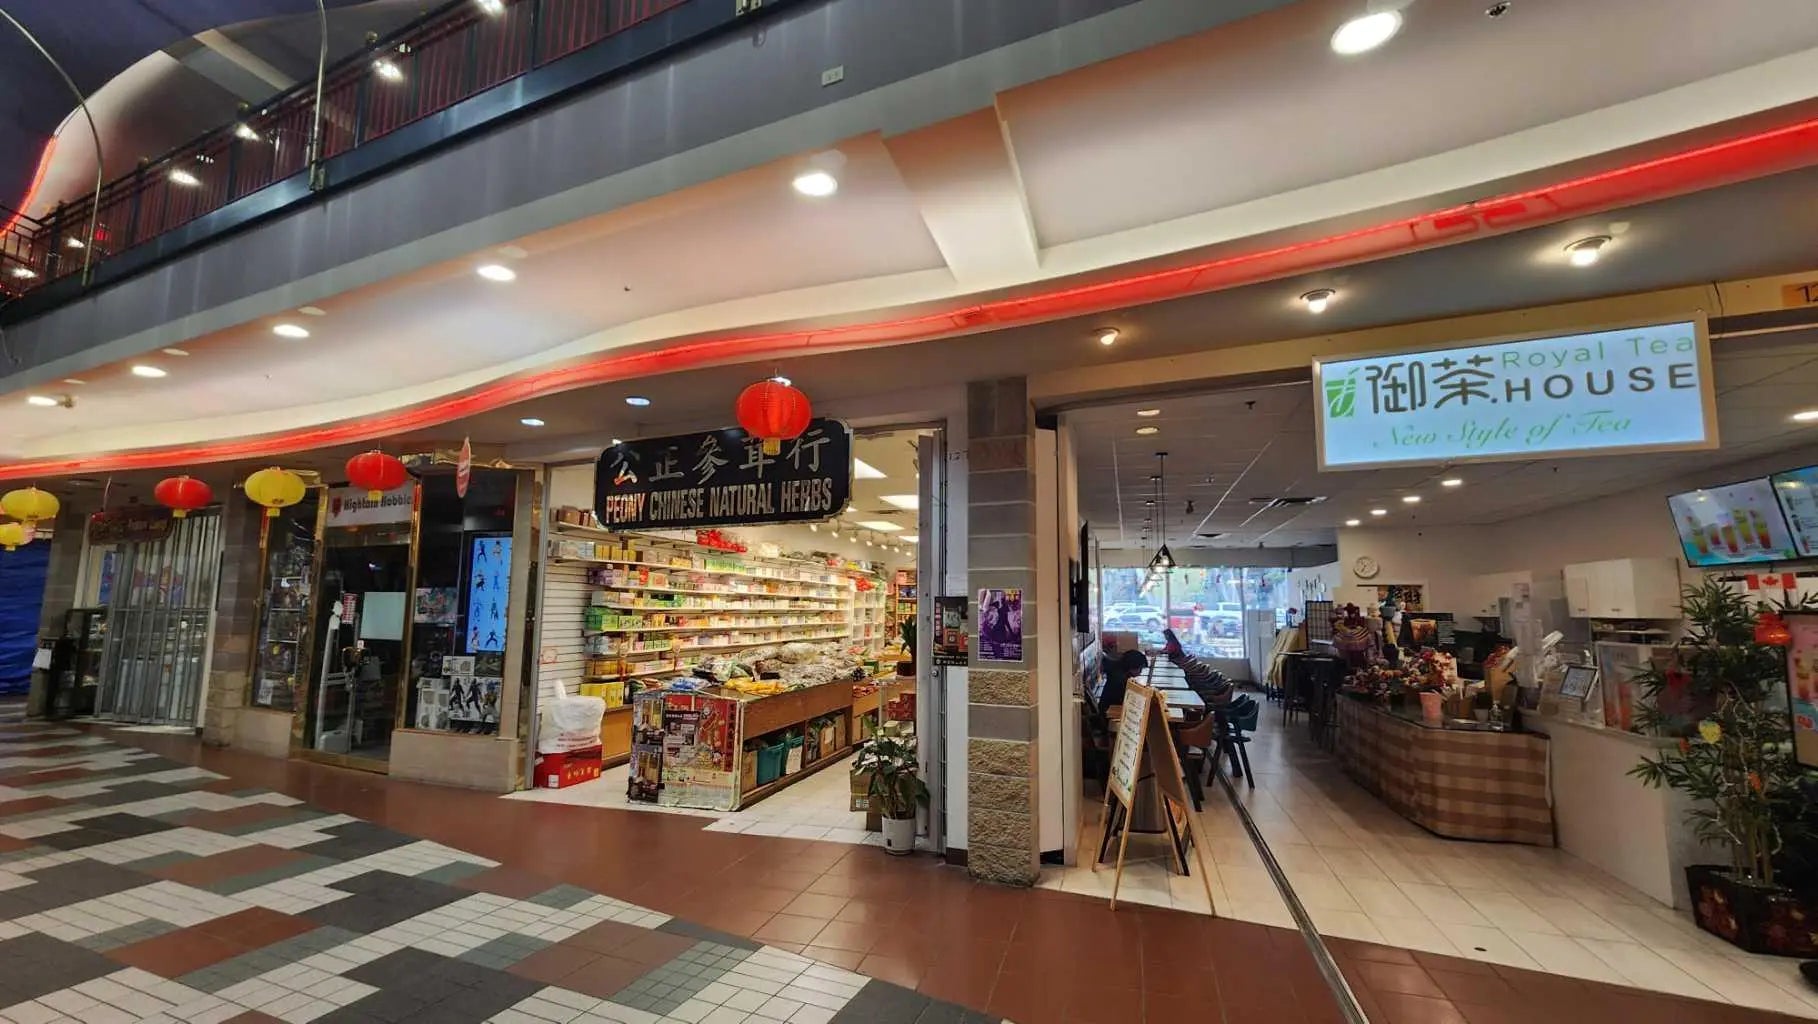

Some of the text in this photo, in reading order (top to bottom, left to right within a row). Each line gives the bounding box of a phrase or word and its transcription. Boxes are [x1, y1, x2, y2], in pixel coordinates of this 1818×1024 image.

[1502, 336, 1694, 368] Royal Tea
[1365, 354, 1495, 414] 御茶
[1505, 363, 1697, 402] HOUSE
[1373, 410, 1632, 448] New Style of Tea
[381, 493, 414, 508] Hobbie
[606, 477, 832, 524] PEONY CHINESE NATURAL HERBS
